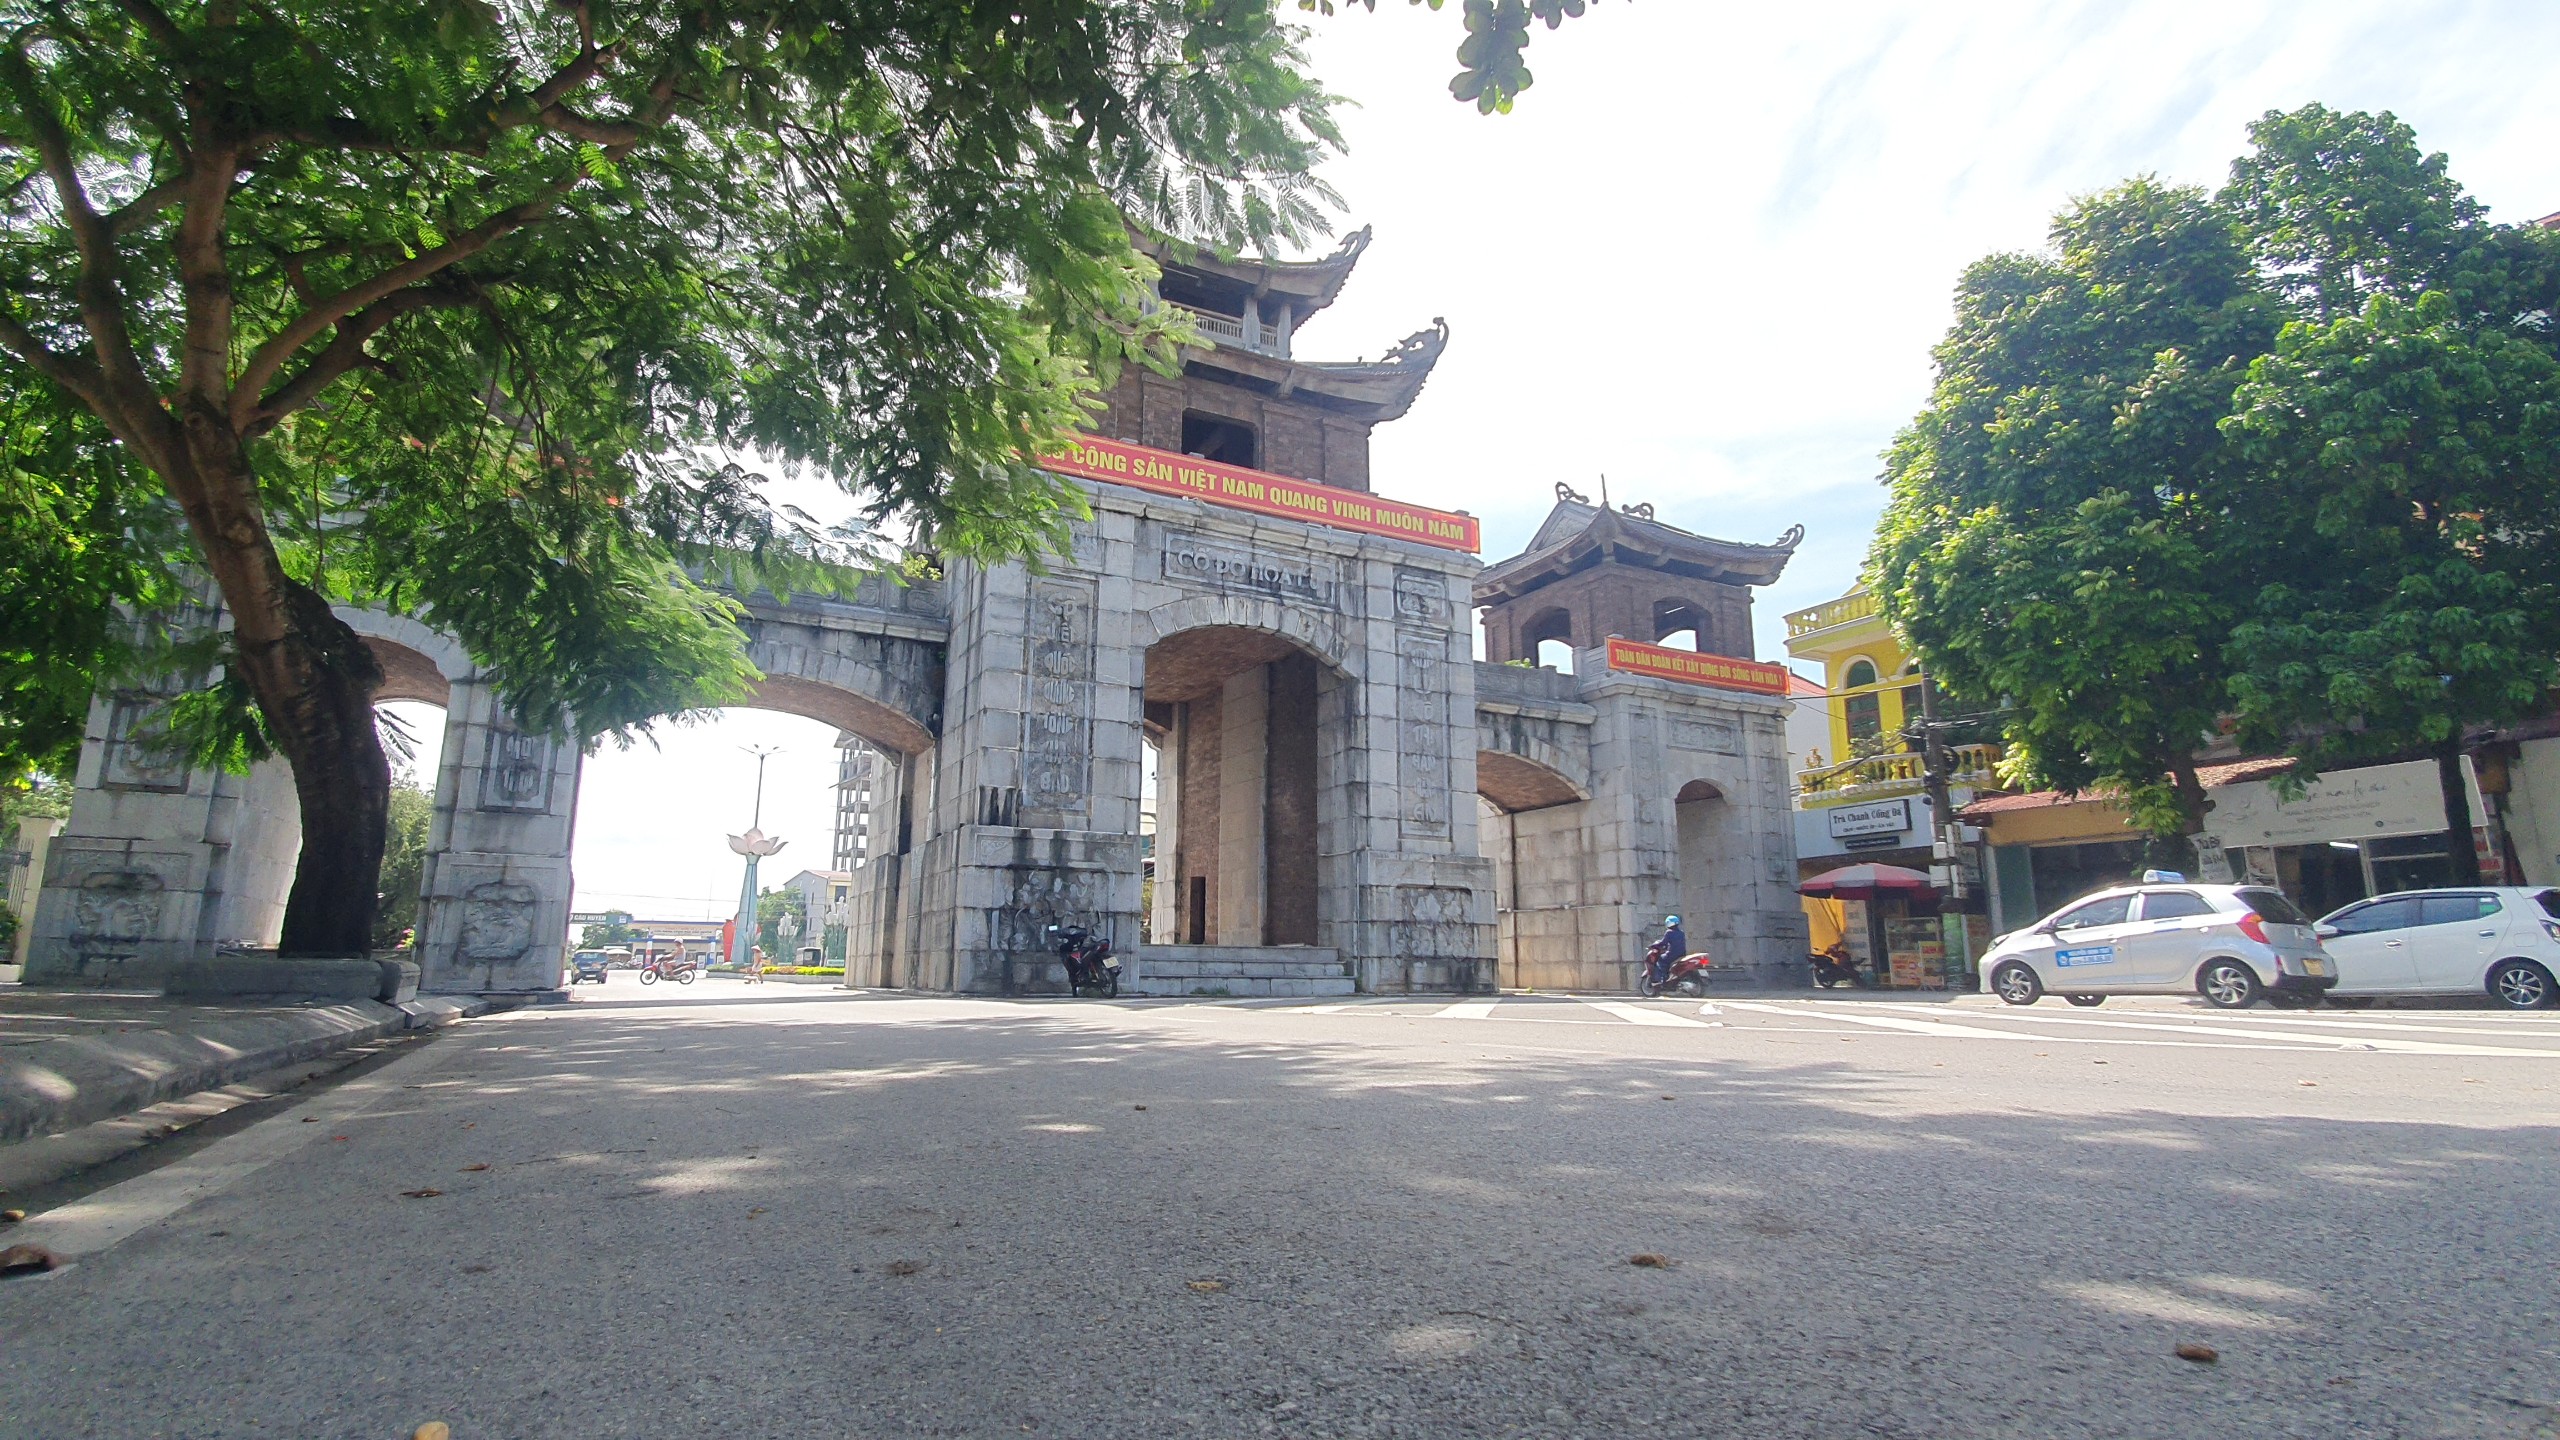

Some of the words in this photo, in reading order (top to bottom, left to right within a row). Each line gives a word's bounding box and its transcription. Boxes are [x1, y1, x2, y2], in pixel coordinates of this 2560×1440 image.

[1072, 446, 1127, 473] CỘNG
[1133, 456, 1173, 482] SẢN
[1178, 468, 1218, 492] VIỆT
[1223, 477, 1265, 500] NAM
[1269, 486, 1328, 513] QUANG
[1332, 500, 1371, 522] VINH
[1376, 508, 1424, 533] MUÔN
[1428, 519, 1465, 541] NĂM
[1847, 811, 1870, 822] Chanh
